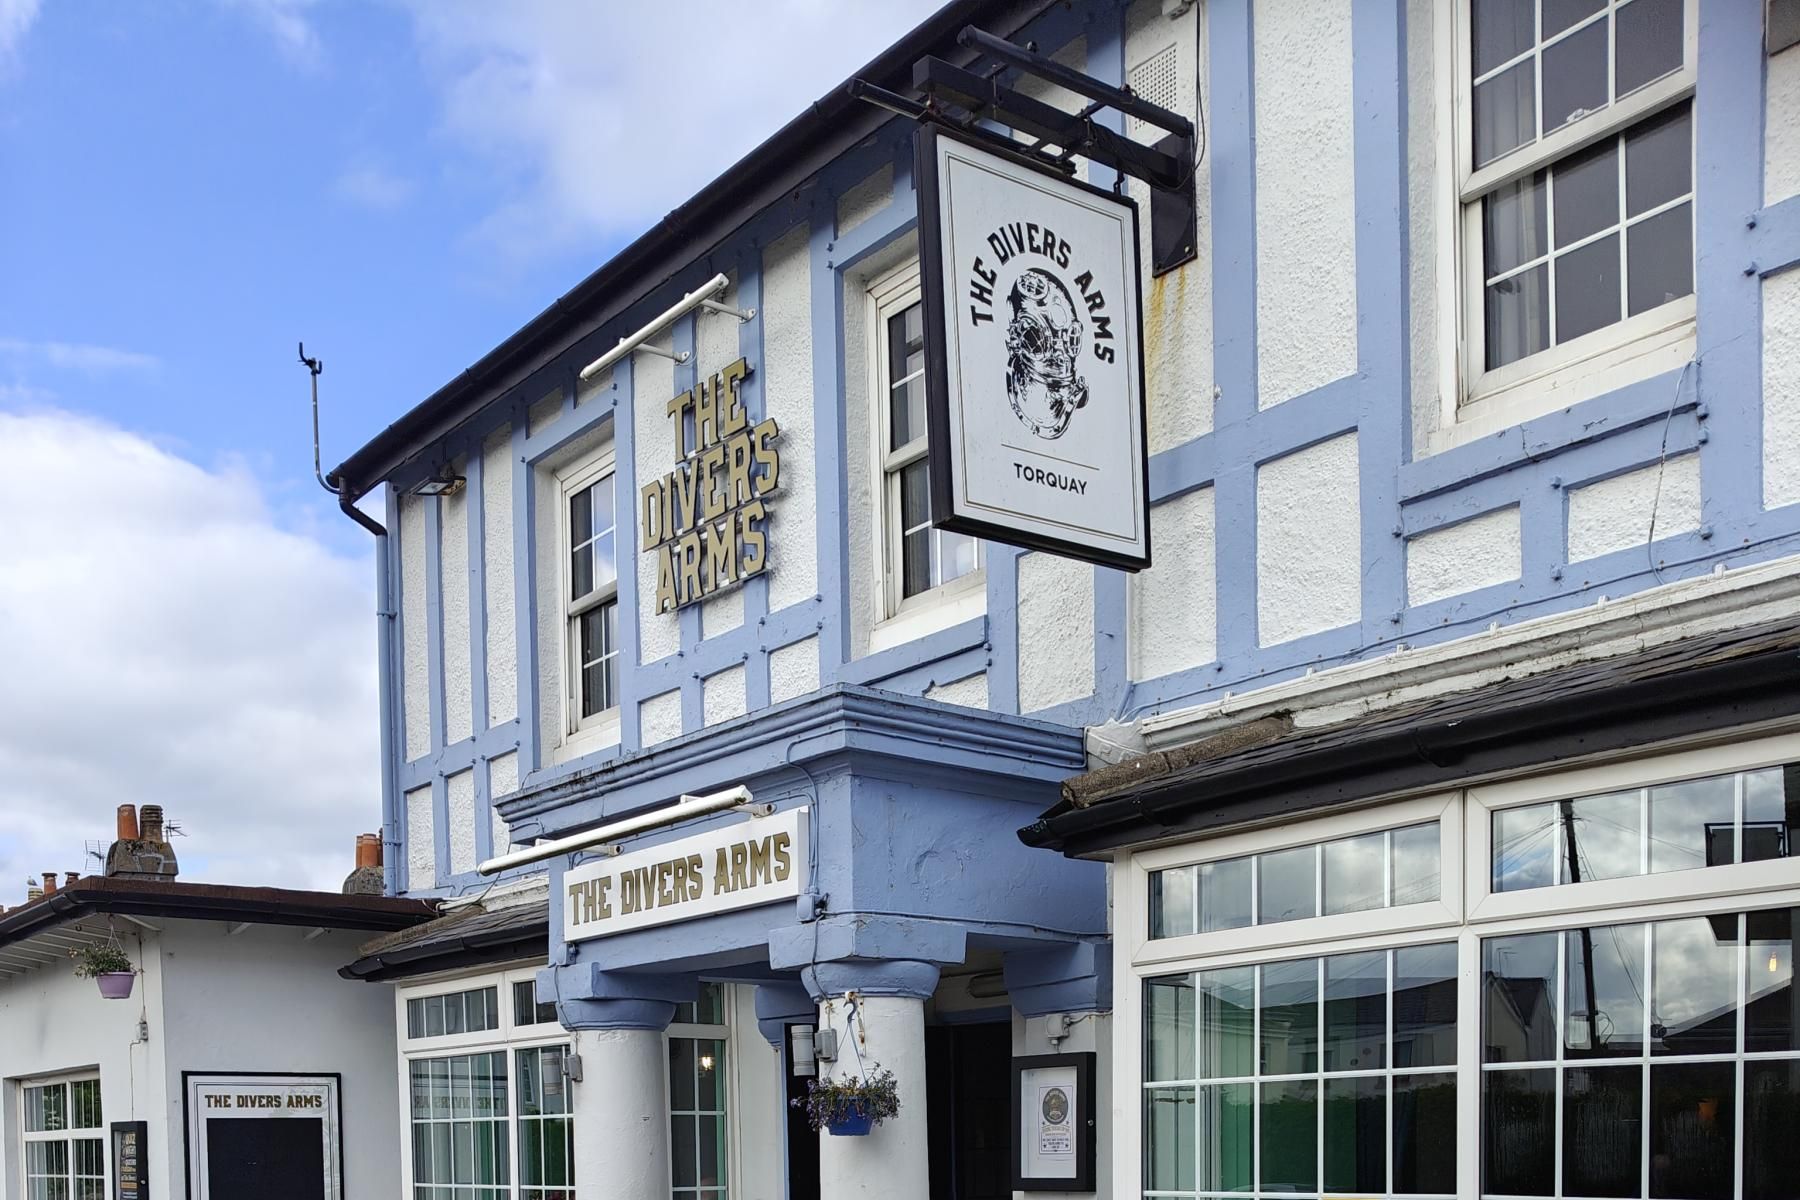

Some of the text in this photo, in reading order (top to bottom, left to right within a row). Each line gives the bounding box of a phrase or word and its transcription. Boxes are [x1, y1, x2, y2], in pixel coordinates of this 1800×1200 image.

[970, 222, 1115, 365] THE DIVERS ARMS
[667, 357, 748, 464] THE
[641, 417, 780, 553] DIVERS
[1013, 462, 1088, 495] TORQUAY
[655, 500, 767, 616] ARMS
[568, 831, 791, 926] THE DIVERS ARMS
[204, 1094, 323, 1108] THE DIVERS ARMS
